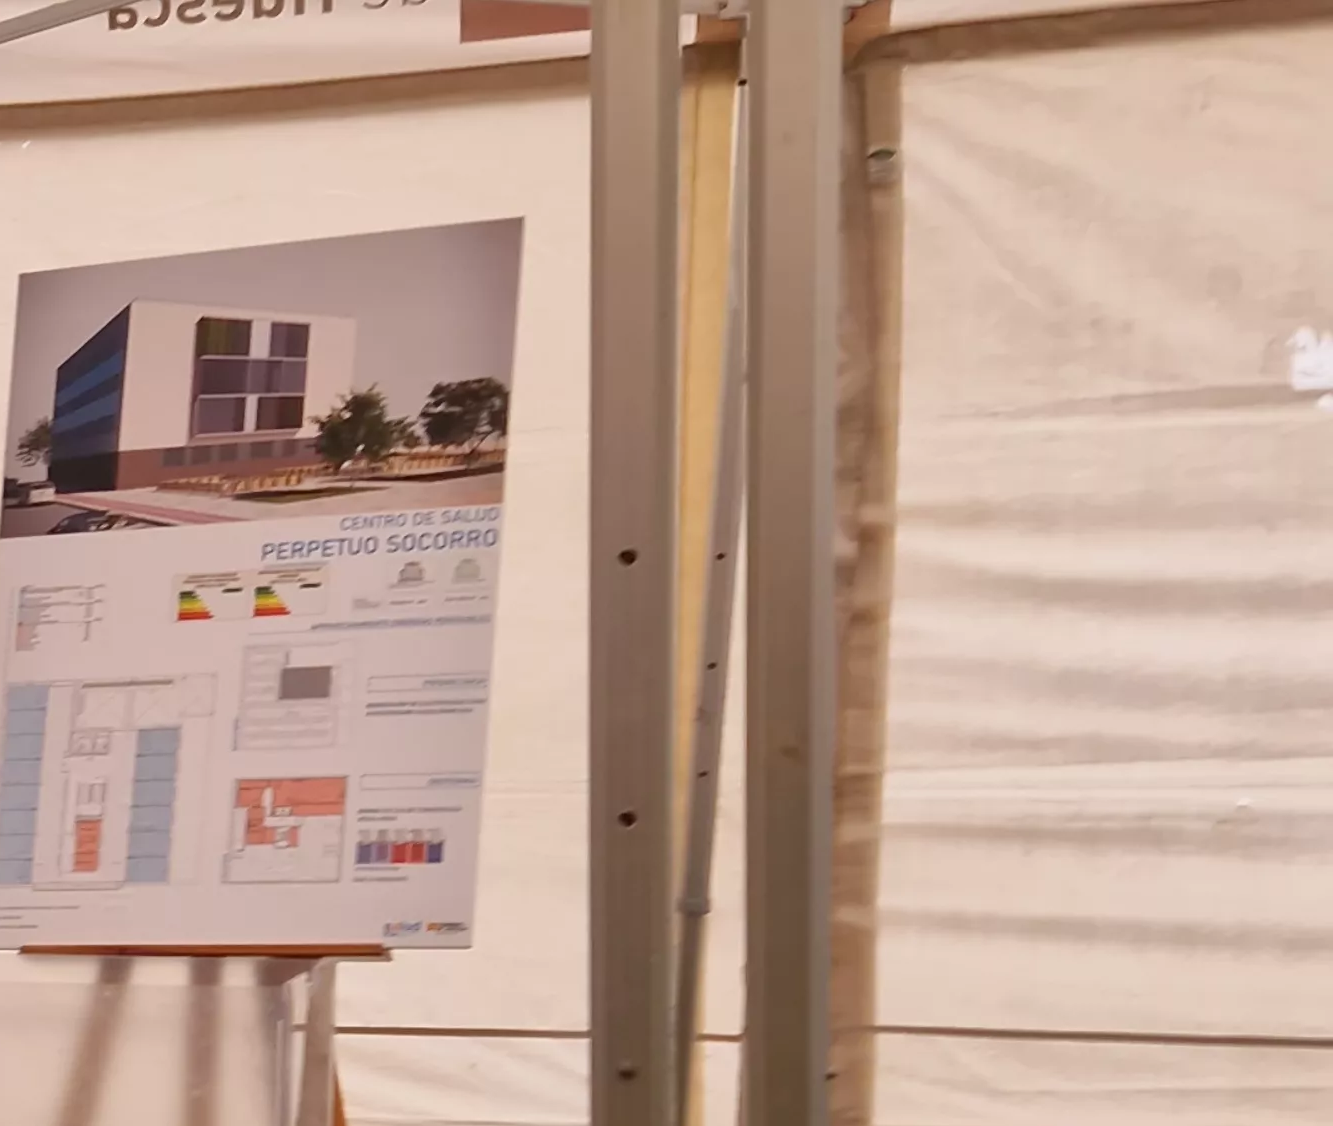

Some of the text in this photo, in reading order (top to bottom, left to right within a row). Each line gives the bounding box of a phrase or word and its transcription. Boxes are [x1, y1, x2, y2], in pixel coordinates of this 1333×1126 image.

[339, 506, 501, 531] CENTRO DE SALUD
[260, 528, 499, 562] PERPETUO SOCORRO
